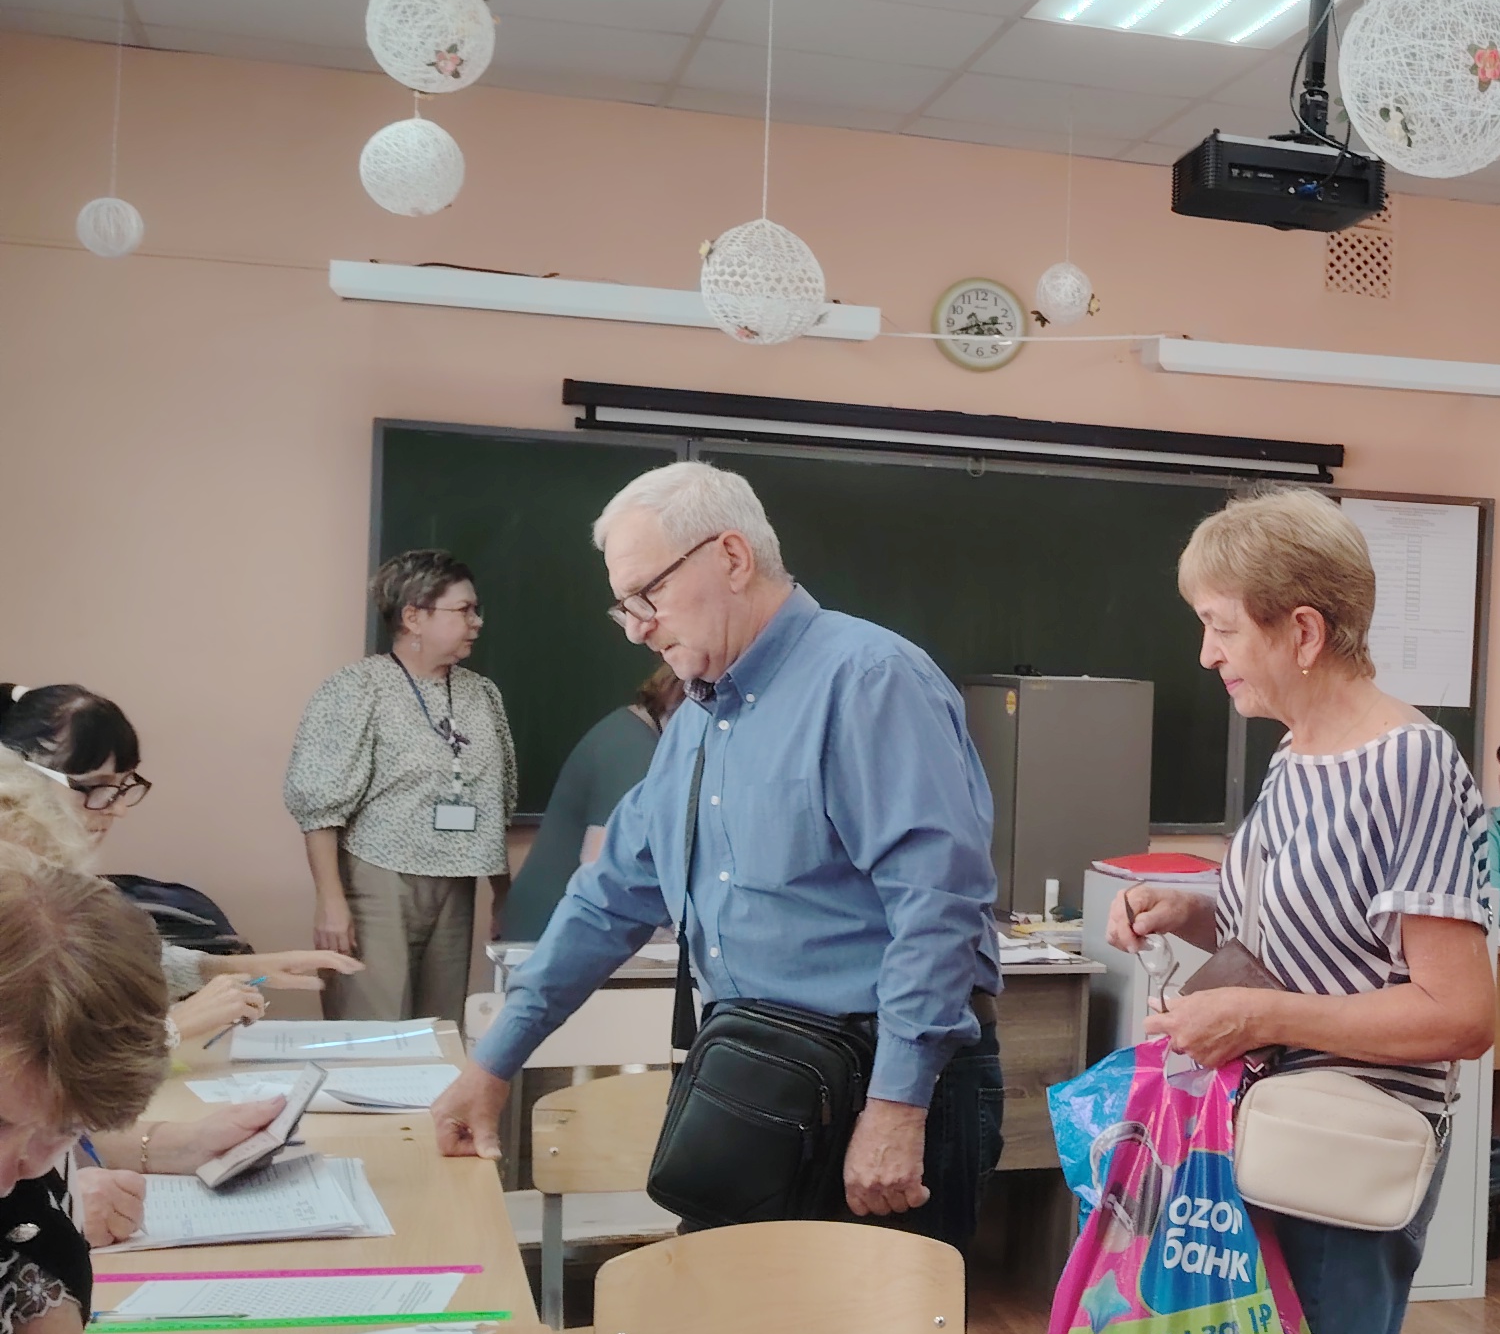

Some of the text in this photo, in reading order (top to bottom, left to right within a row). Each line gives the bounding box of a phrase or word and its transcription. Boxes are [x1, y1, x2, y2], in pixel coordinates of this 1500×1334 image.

[962, 294, 971, 304] 11
[975, 291, 988, 301] 12
[952, 305, 963, 315] 10
[1001, 308, 1008, 318] 2
[946, 318, 955, 327] 9
[1005, 322, 1013, 331] 3
[976, 347, 984, 356] 6
[990, 345, 999, 354] 5
[1162, 1227, 1250, 1283] банк
